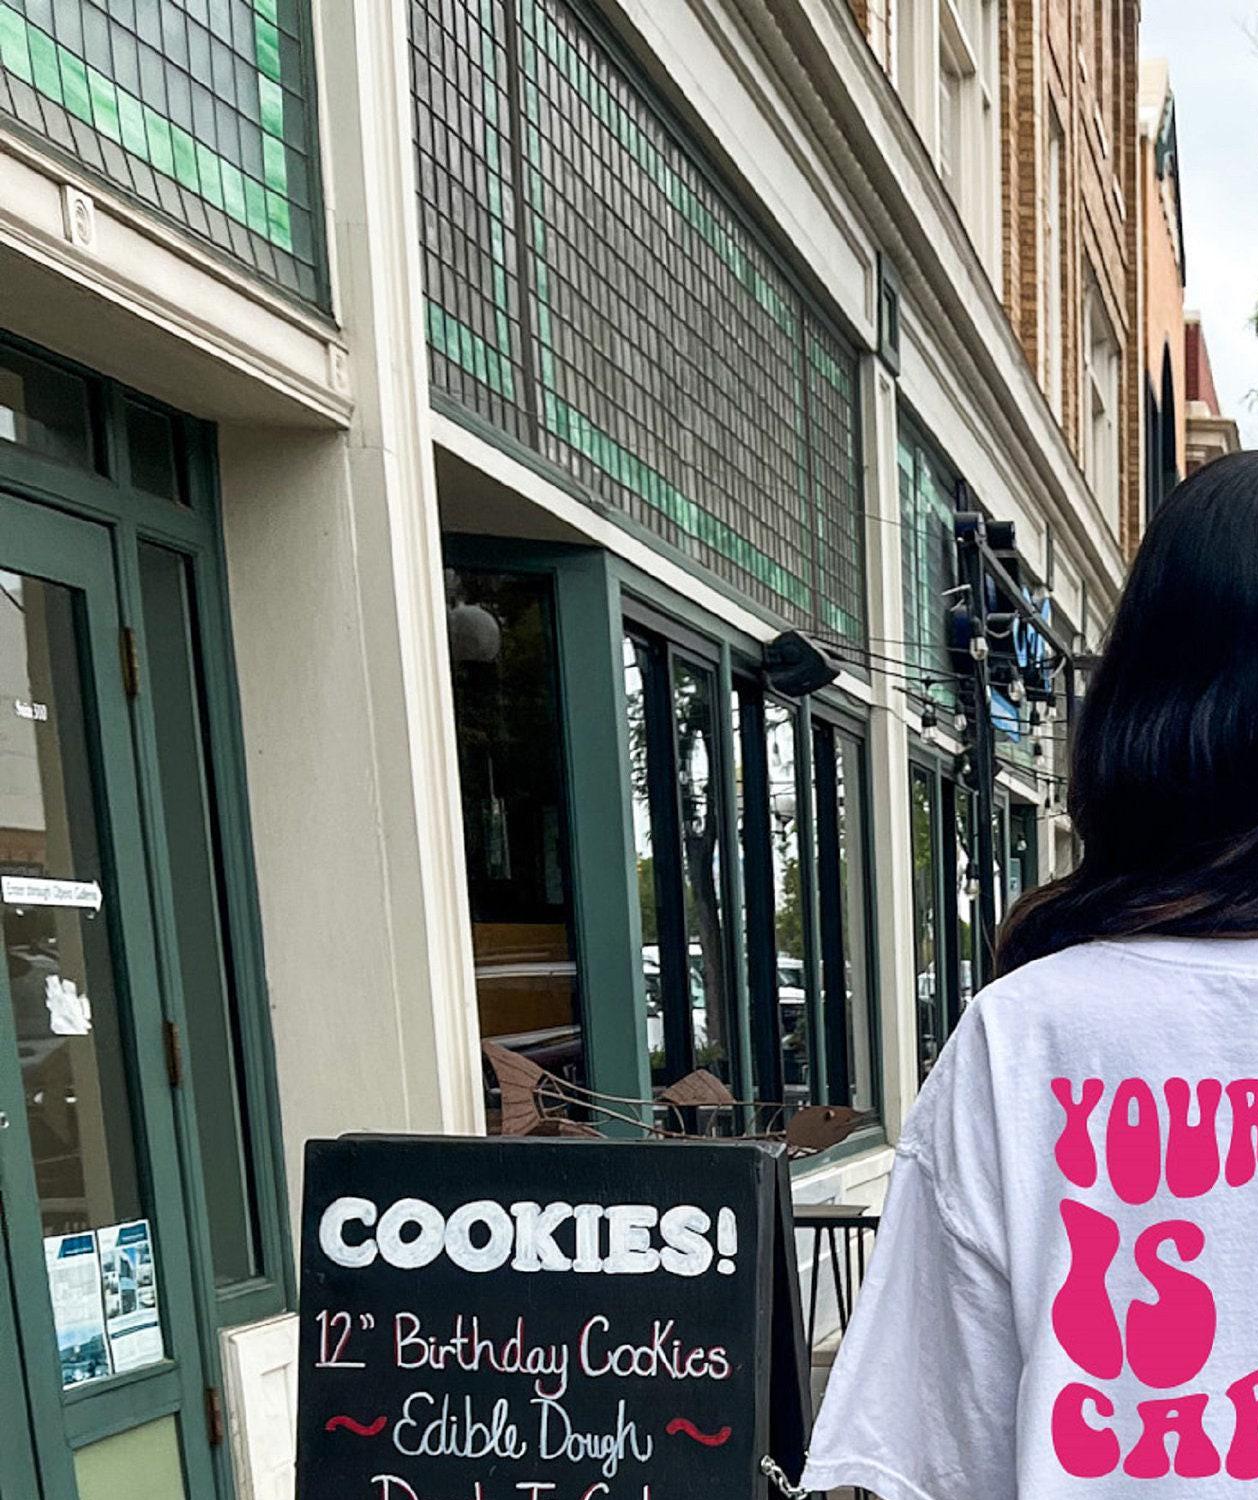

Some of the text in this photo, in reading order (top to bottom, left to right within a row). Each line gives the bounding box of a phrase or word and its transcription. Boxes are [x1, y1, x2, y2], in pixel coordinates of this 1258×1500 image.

[318, 1196, 739, 1277] COOKIES!
[1052, 1198, 1217, 1389] IS
[395, 1312, 569, 1398] Birthday
[393, 1391, 653, 1478] Edible Dough
